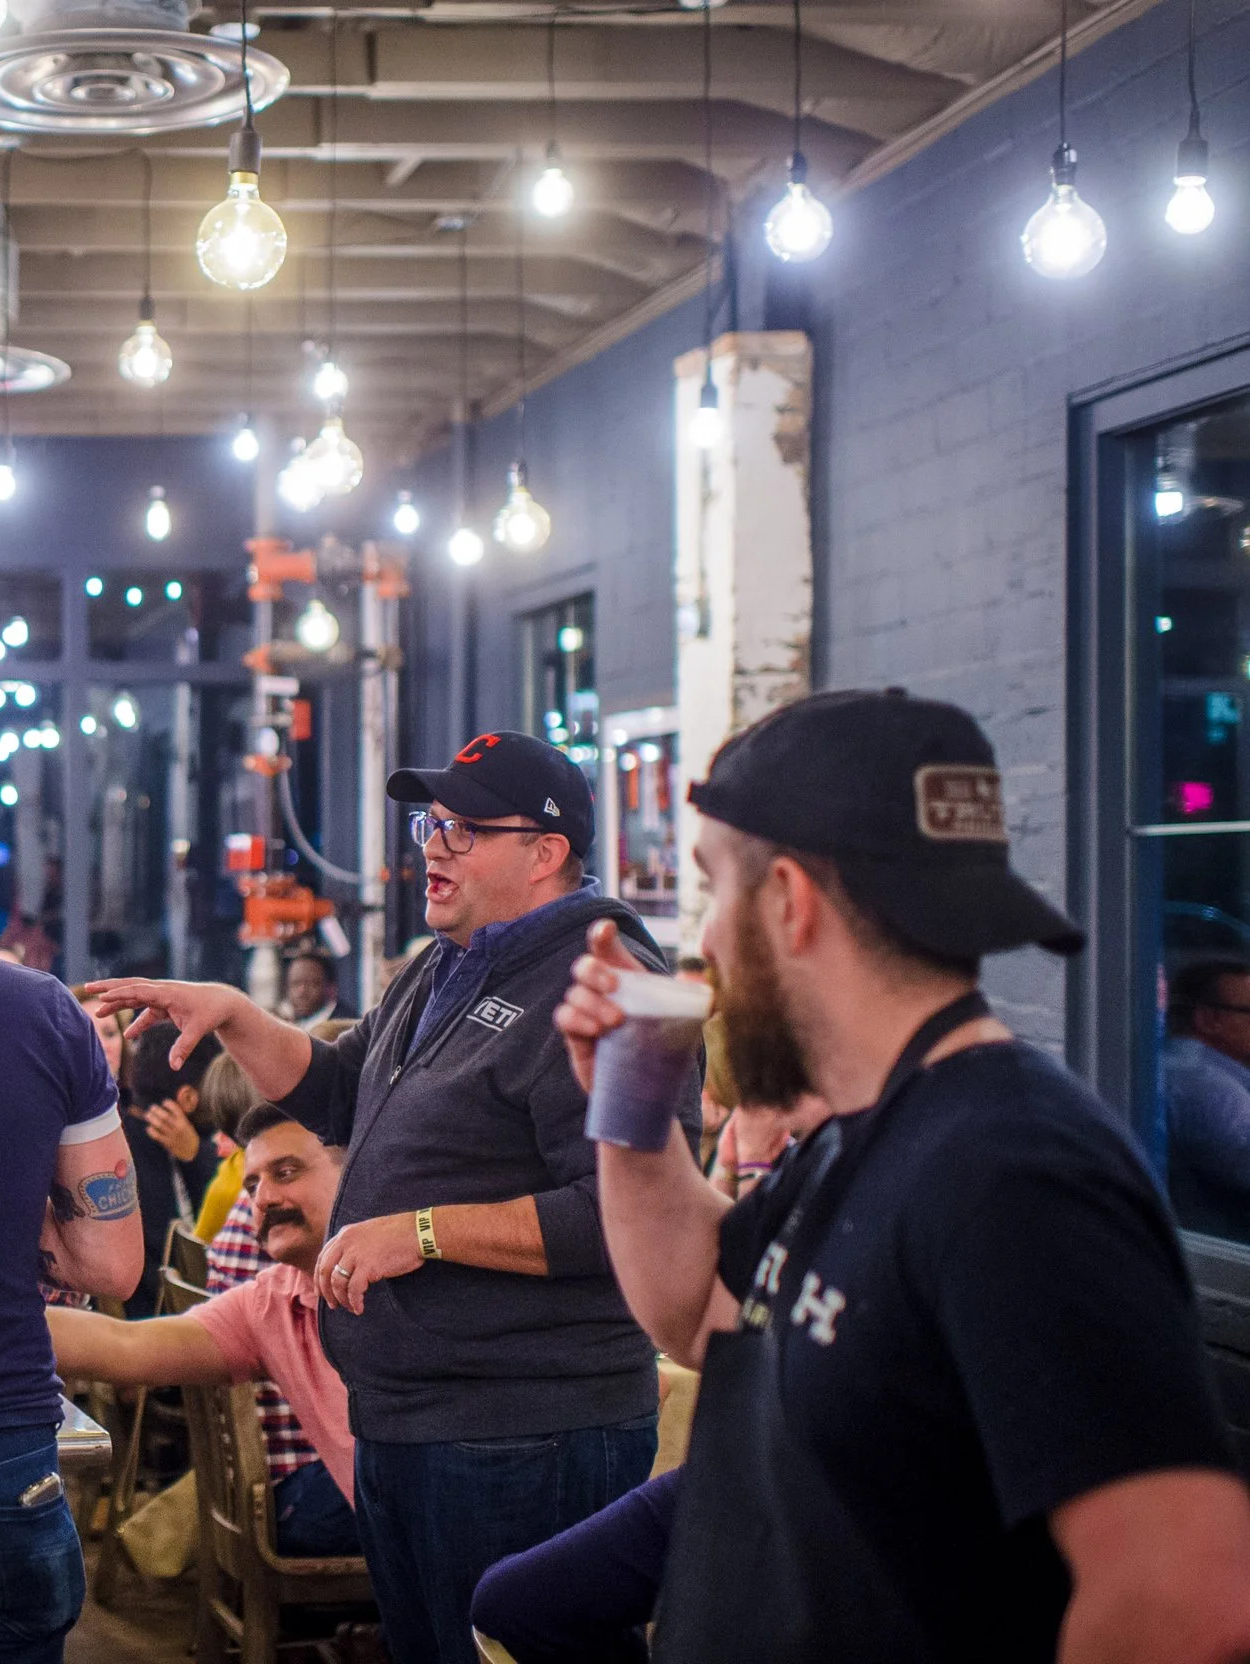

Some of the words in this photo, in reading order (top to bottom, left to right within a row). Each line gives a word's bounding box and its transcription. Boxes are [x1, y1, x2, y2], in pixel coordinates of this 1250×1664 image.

[455, 733, 501, 763] C
[419, 1217, 431, 1232] VIP
[422, 1238, 436, 1256] VIP
